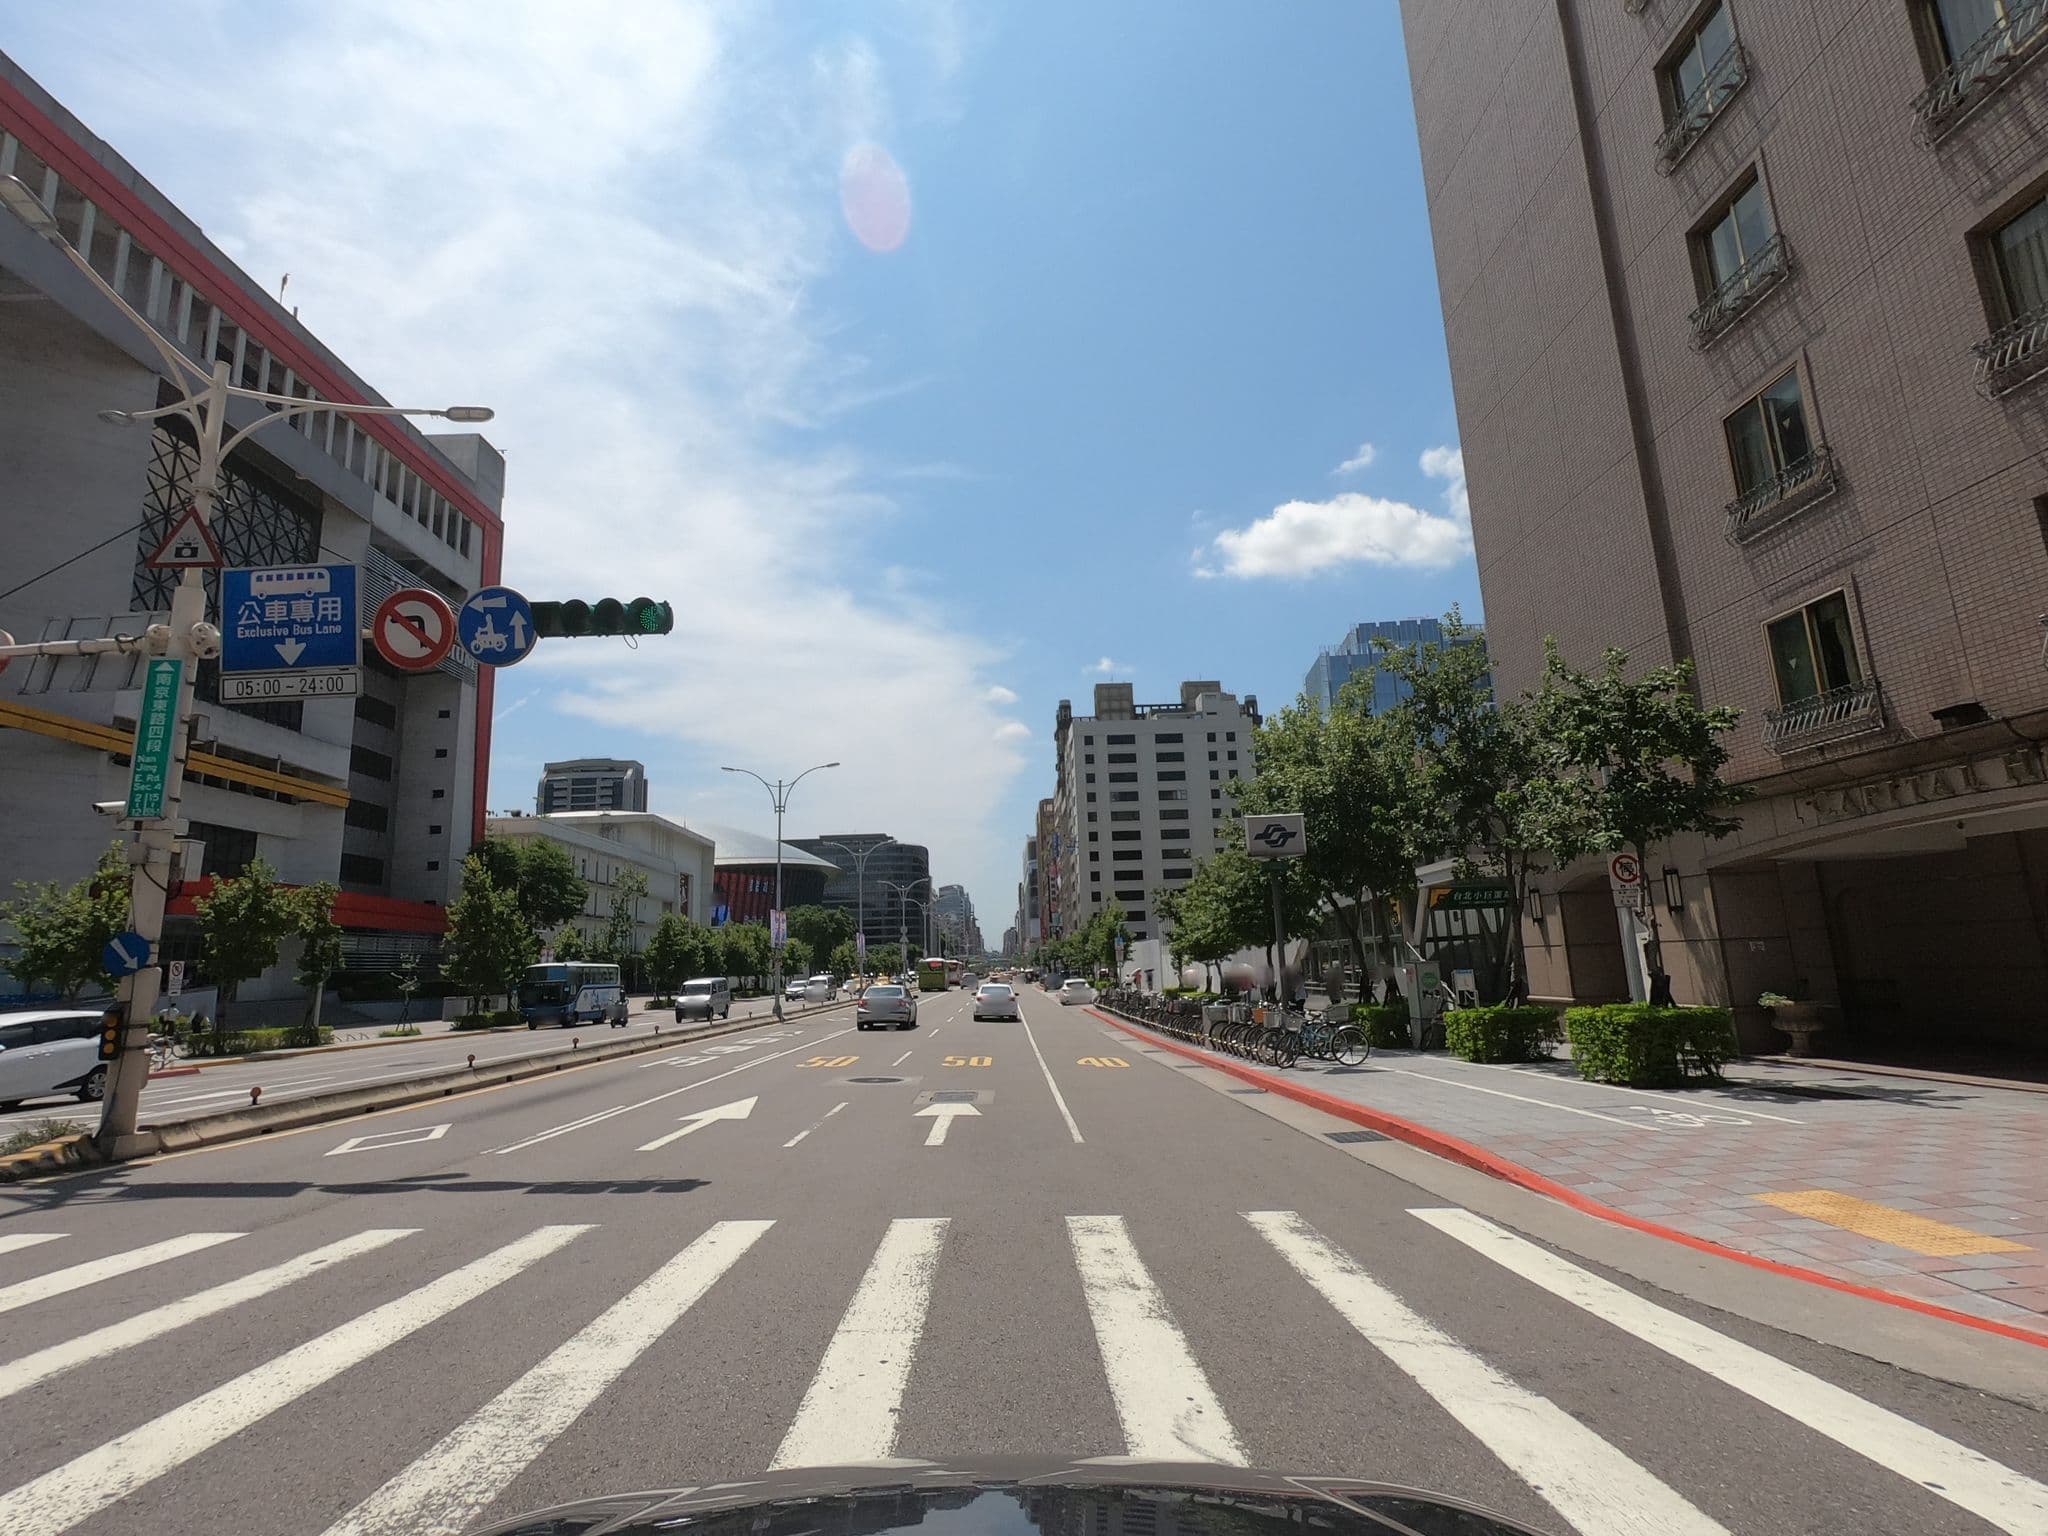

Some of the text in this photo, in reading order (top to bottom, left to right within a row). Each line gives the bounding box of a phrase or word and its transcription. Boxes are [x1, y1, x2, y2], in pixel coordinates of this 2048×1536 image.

[238, 597, 342, 625] 公車專用
[237, 623, 342, 638] Exclusive Bus Lane
[236, 679, 280, 696] 05:00
[300, 676, 344, 693] 24:00
[145, 673, 172, 753] 南京東路四段
[795, 1055, 860, 1067] 50
[941, 1056, 993, 1067] 50
[1075, 1056, 1131, 1068] 40
